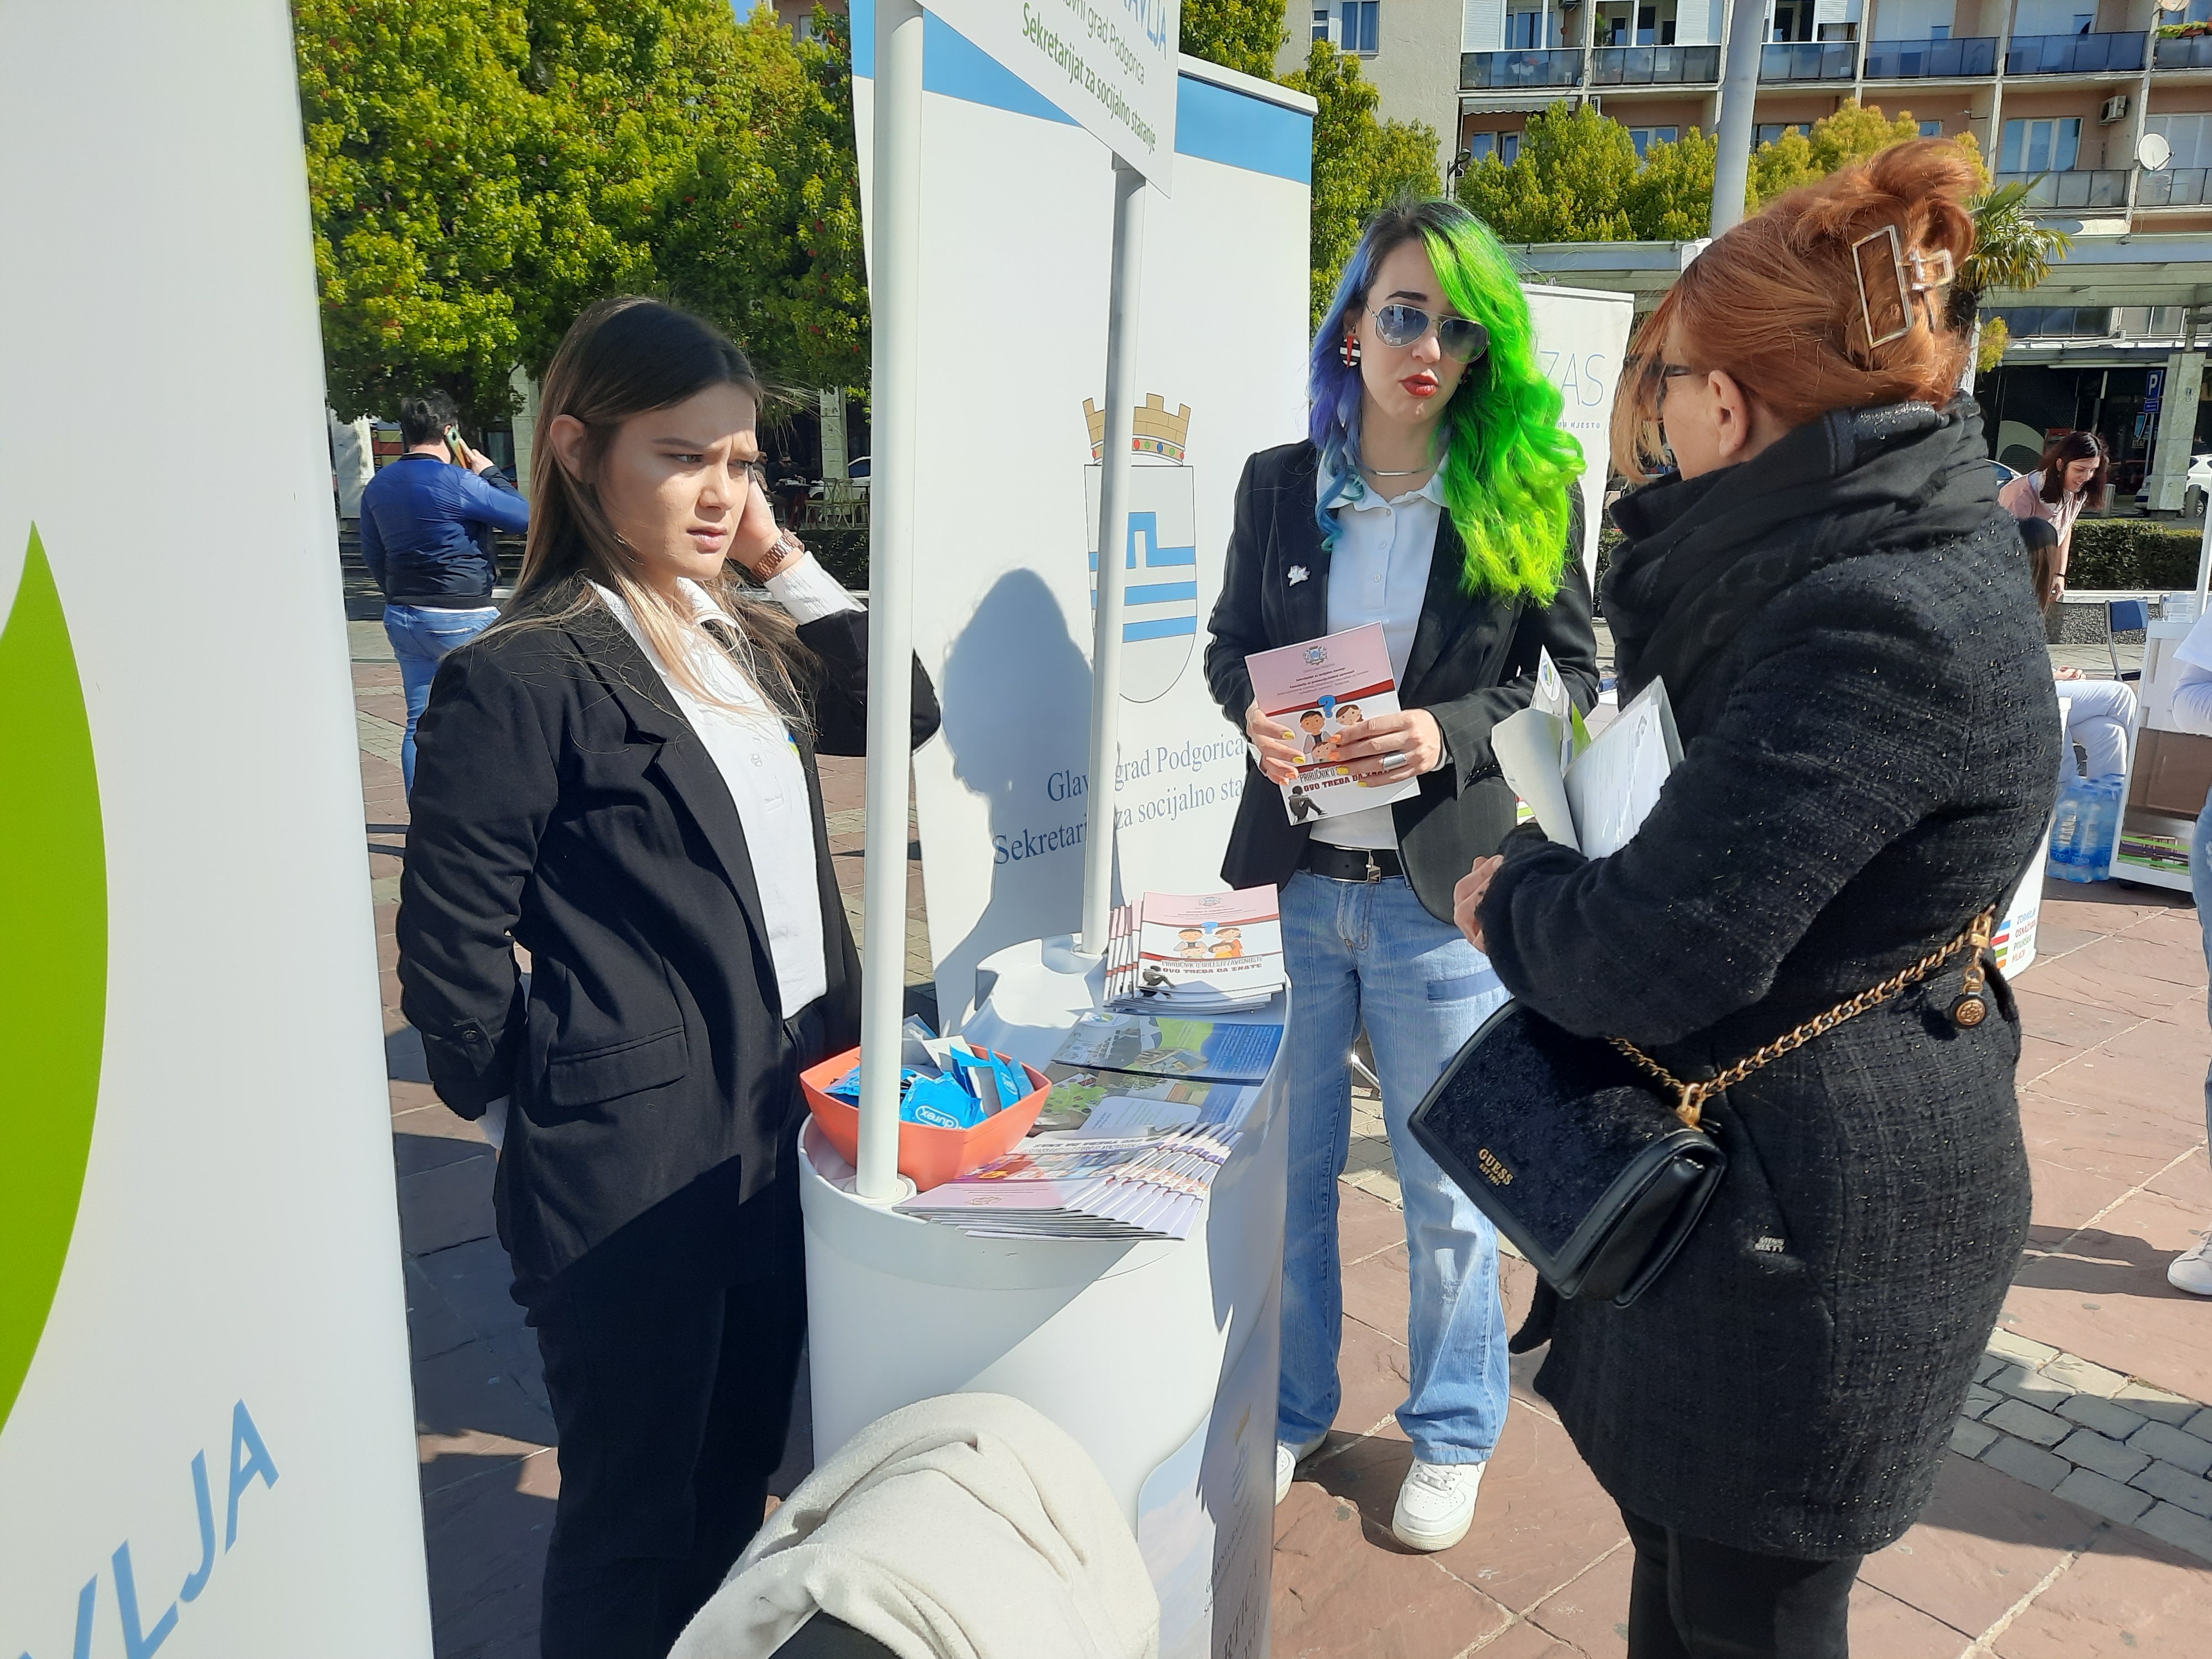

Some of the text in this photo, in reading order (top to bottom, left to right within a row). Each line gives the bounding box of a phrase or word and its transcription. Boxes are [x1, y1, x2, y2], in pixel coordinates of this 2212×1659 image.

[1087, 7, 1109, 45] grad
[1109, 23, 1145, 85] Podgorica
[1022, 2, 1156, 155] Sekretarijat za socijalno staranje
[2148, 374, 2158, 396] P
[1114, 748, 1151, 792] grad
[1156, 733, 1244, 774] Podgorica
[1300, 768, 1330, 783] PRIRUČNIK
[1303, 783, 1320, 792] OVO
[1322, 776, 1351, 789] TREBA
[1114, 807, 1133, 830] za
[1138, 783, 1215, 823] socijalno
[1220, 776, 1244, 801] sta
[920, 1107, 954, 1128] durex
[1479, 1149, 1514, 1185] GUESS
